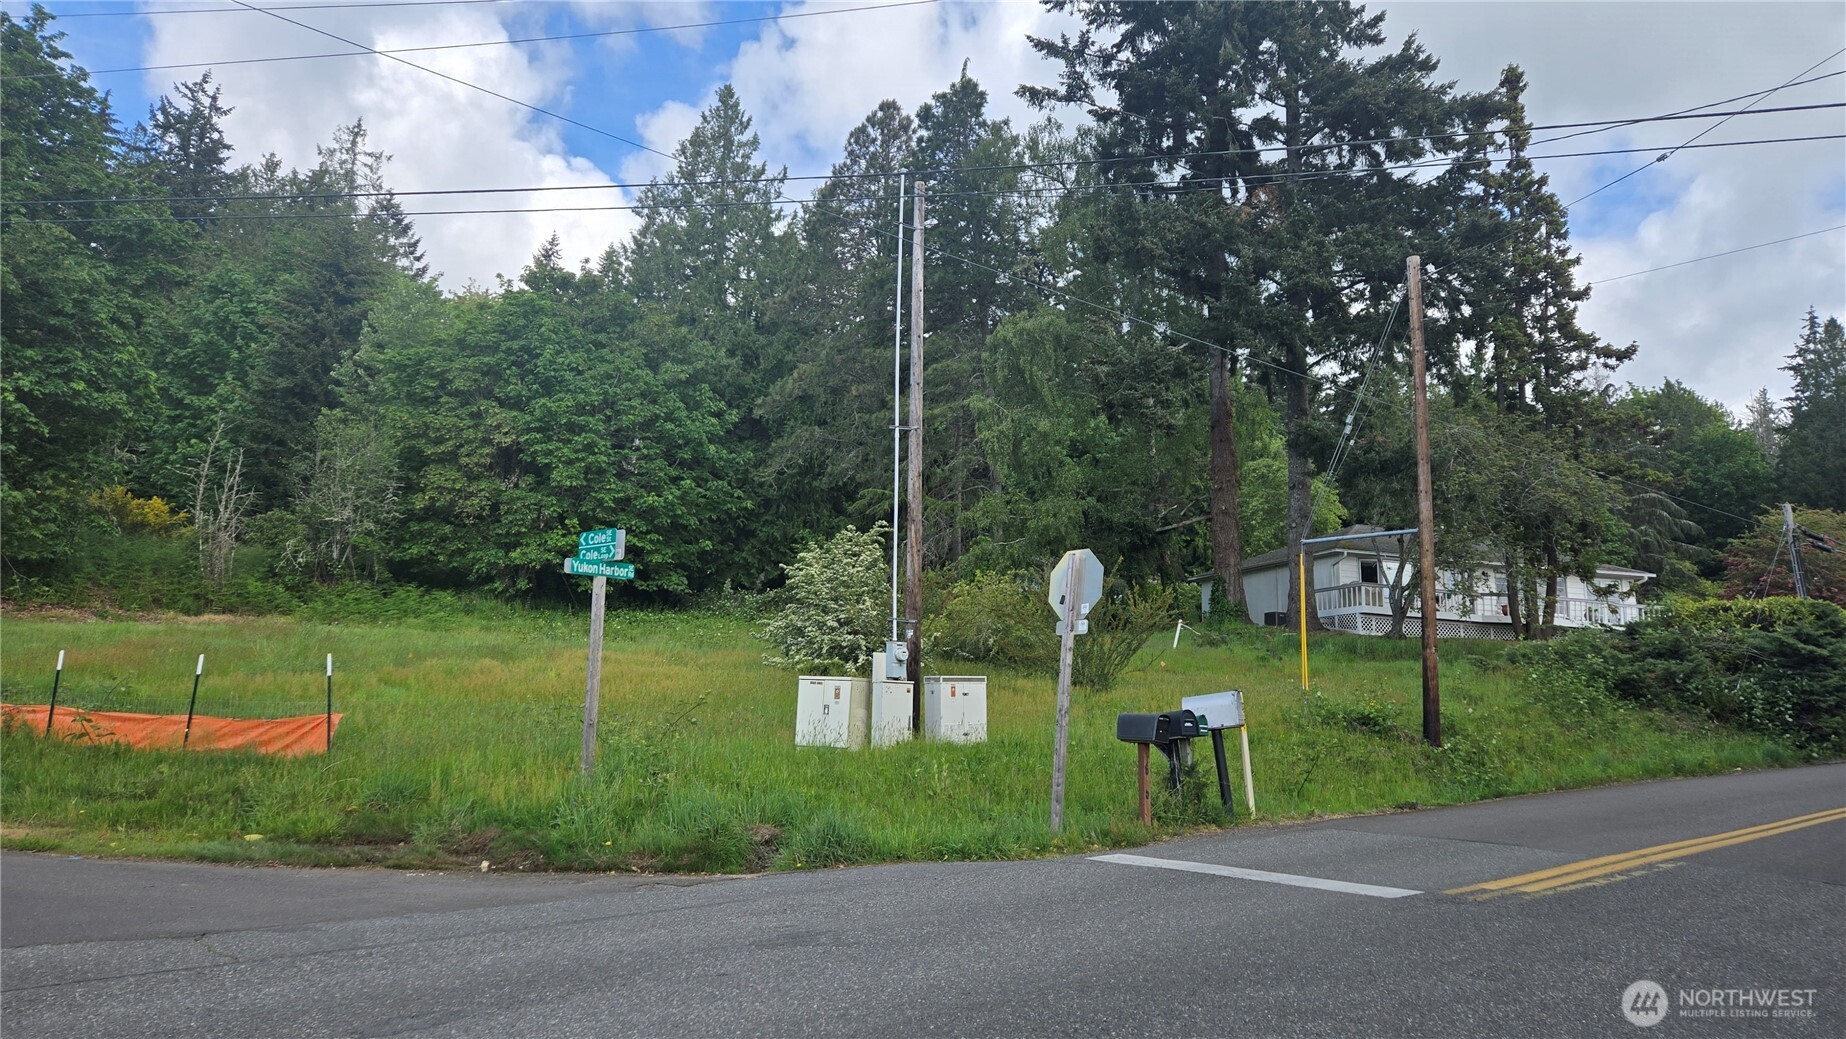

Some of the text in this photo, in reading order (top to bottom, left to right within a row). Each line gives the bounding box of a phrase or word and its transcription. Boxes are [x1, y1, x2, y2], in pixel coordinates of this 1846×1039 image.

[588, 533, 606, 544] Cole
[580, 550, 598, 560] Cole
[572, 560, 628, 576] Yukon Harbor
